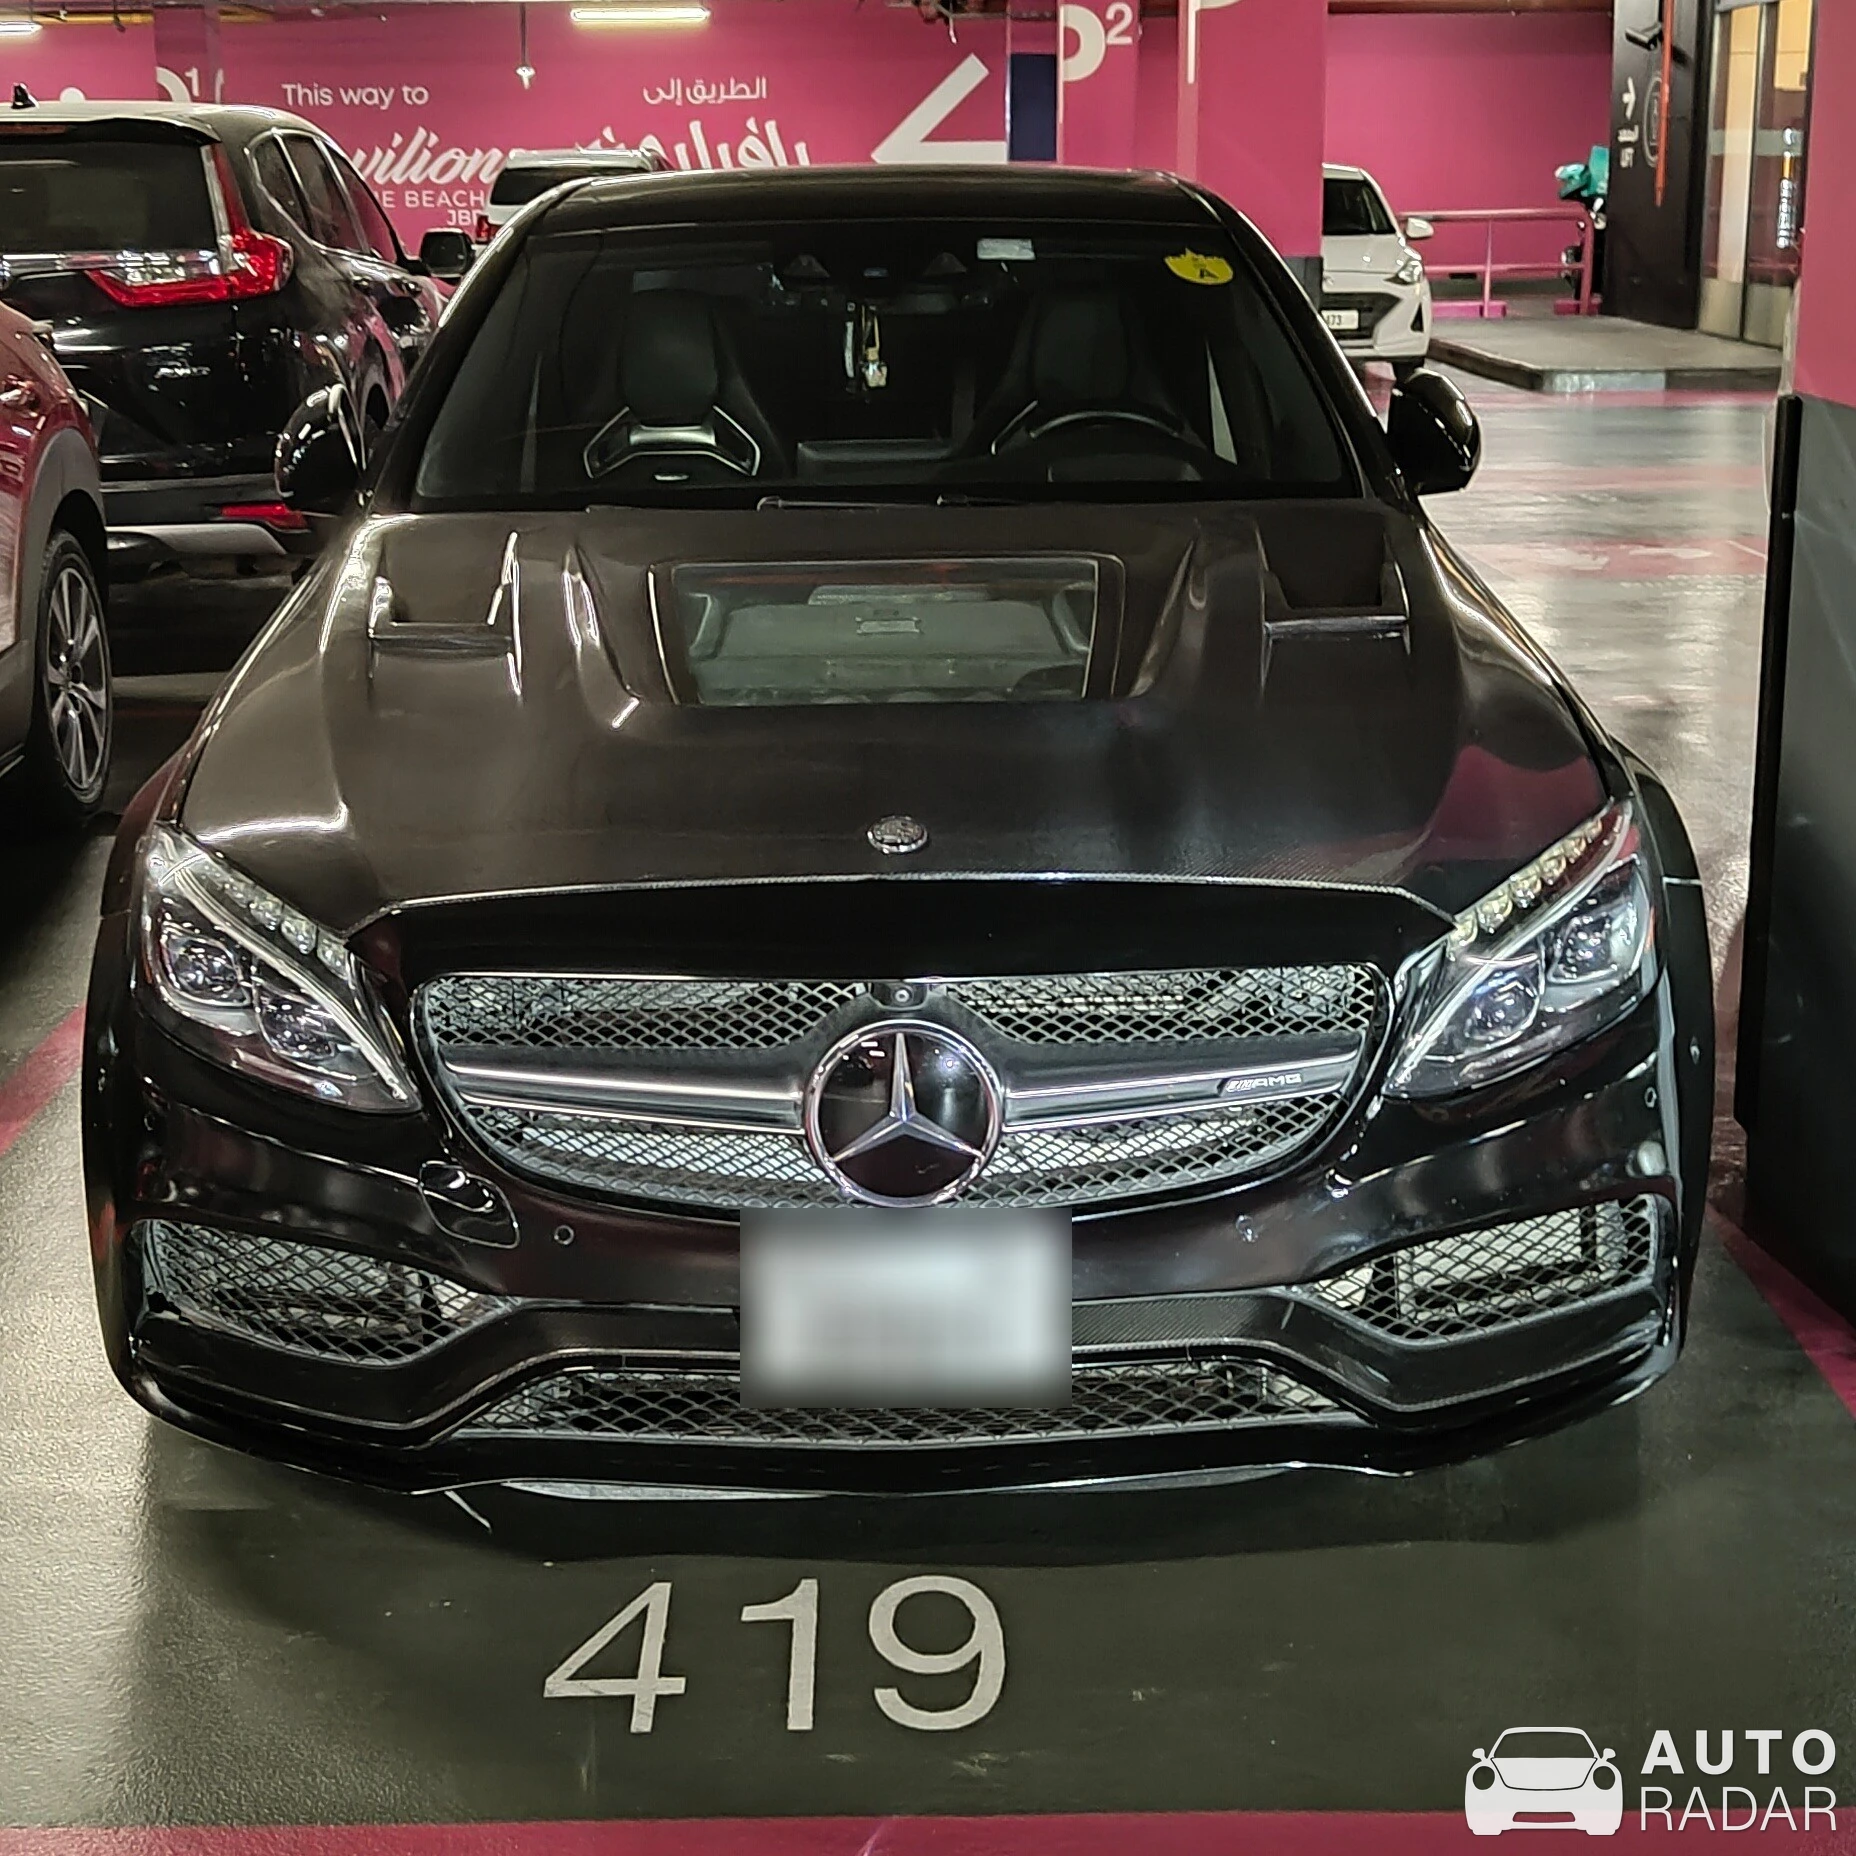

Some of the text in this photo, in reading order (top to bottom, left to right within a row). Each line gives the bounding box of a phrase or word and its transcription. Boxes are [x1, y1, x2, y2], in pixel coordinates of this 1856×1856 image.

[281, 81, 430, 111] This way to
[641, 75, 768, 107] الطريق إلى
[404, 189, 485, 208] BEACH
[543, 1574, 1007, 1734] 419
